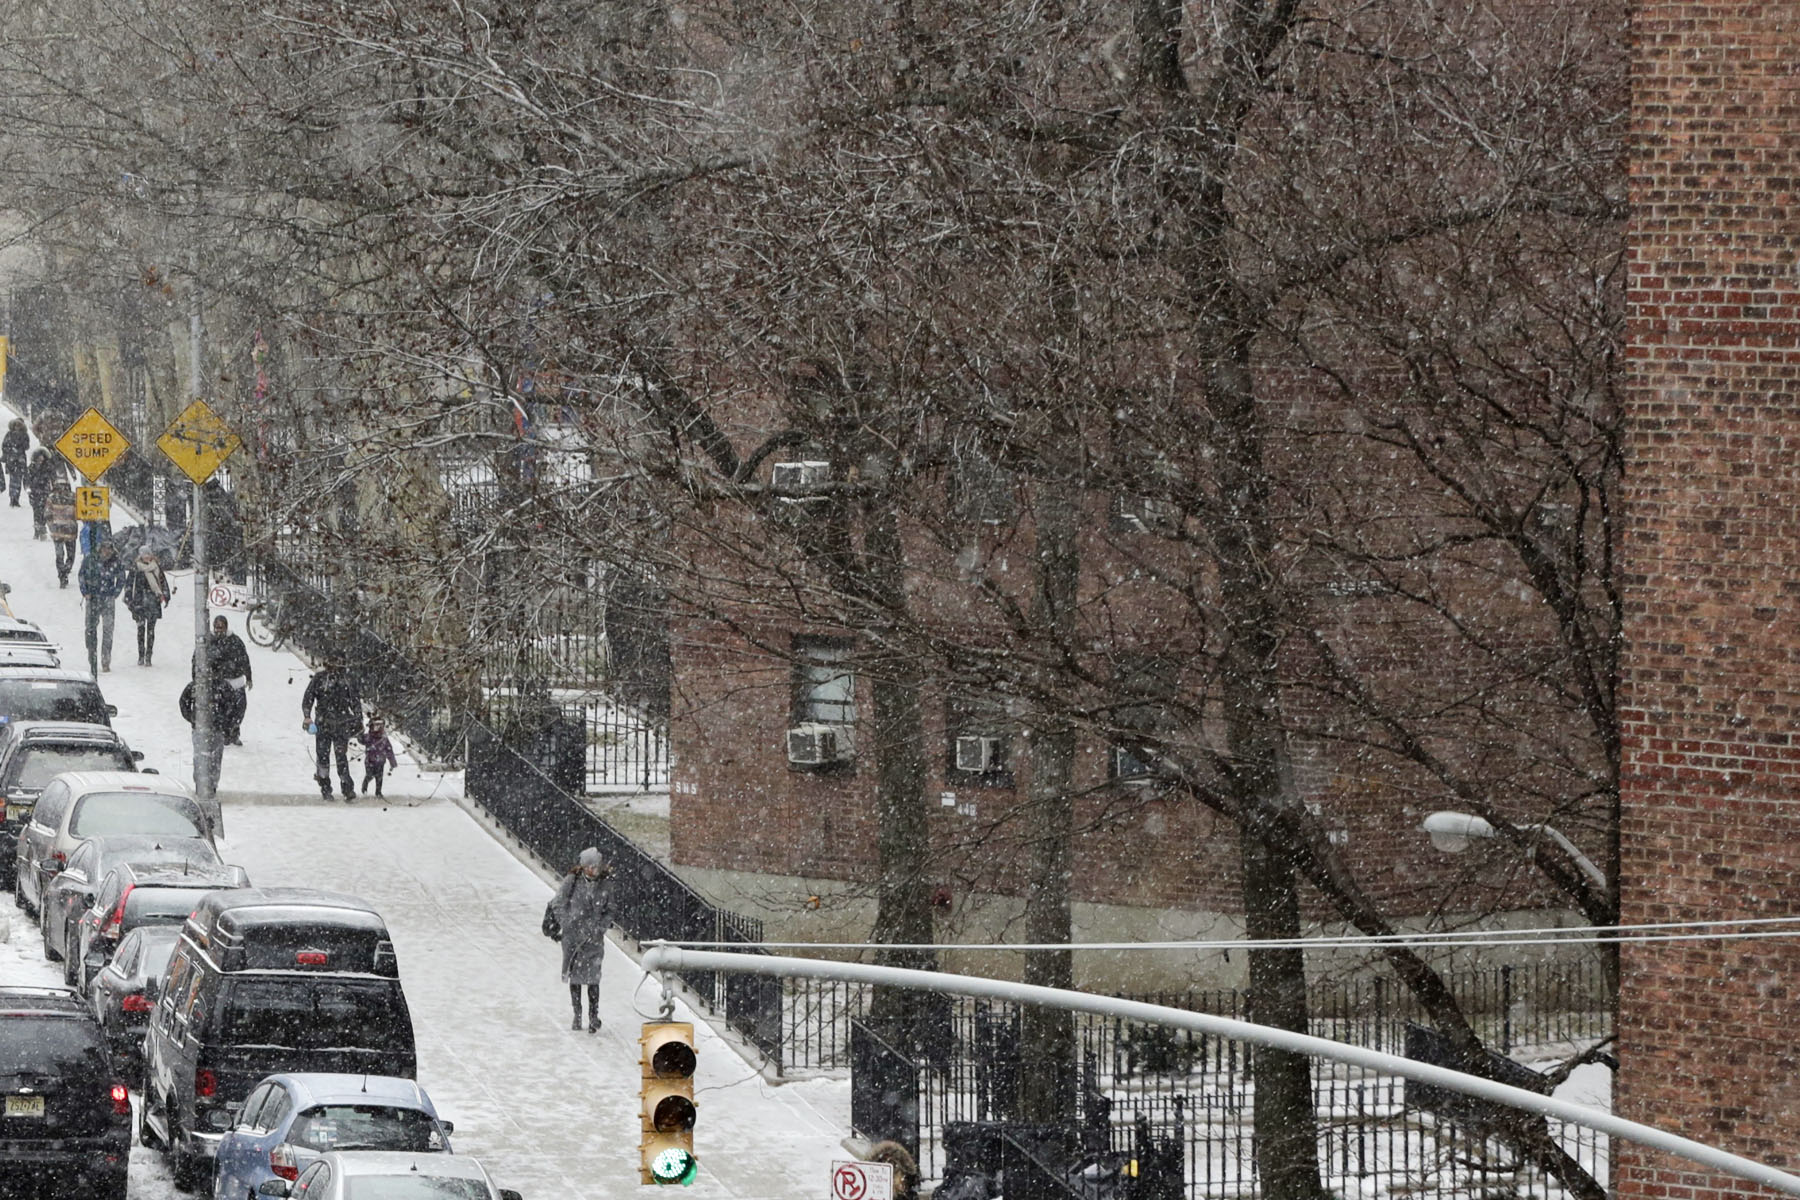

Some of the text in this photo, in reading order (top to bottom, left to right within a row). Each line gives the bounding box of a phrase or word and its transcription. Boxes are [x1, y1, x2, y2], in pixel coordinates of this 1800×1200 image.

[72, 433, 112, 444] SPEED
[75, 447, 109, 458] BUMP
[82, 491, 104, 506] 15
